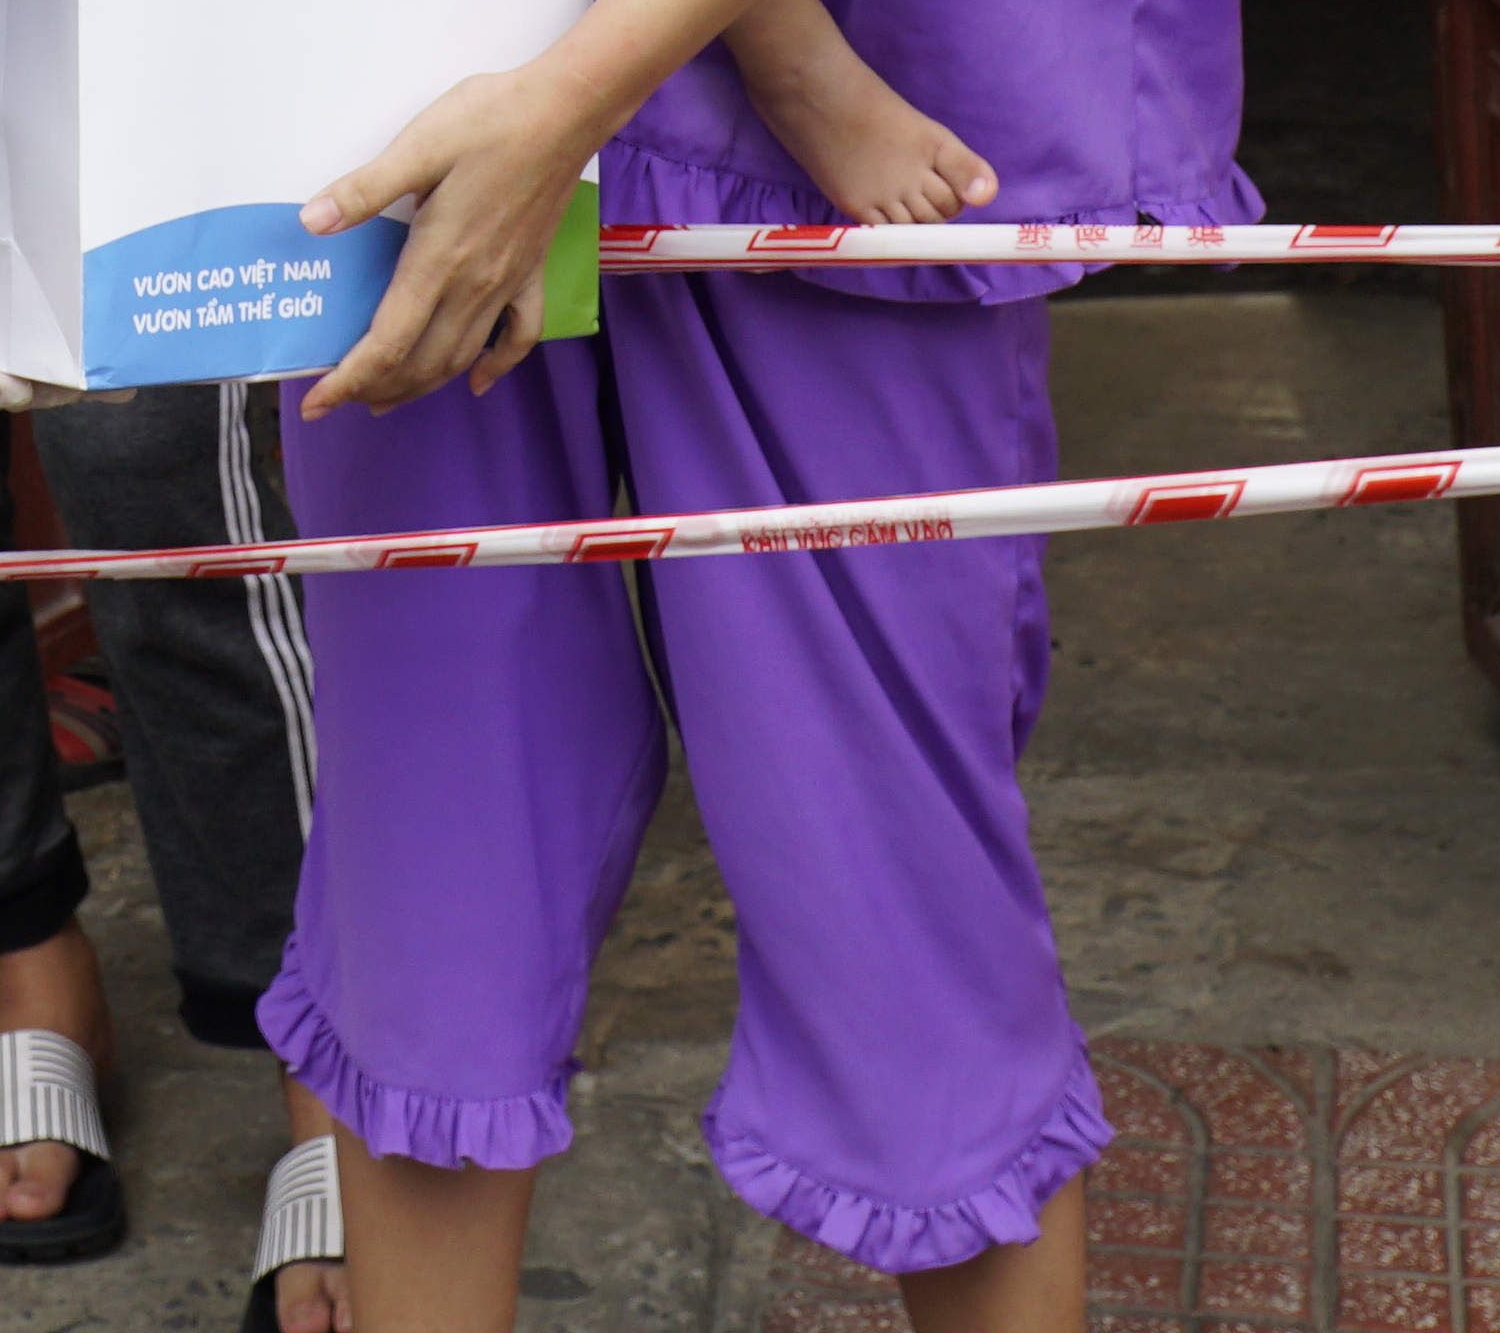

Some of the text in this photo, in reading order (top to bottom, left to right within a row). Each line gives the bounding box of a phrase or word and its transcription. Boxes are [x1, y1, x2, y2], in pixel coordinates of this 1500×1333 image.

[134, 258, 331, 297] VƯƠN CAO VIỆT NAM
[133, 308, 191, 334] VƯƠN
[238, 292, 276, 322] THẾ
[278, 290, 323, 318] GIỚI
